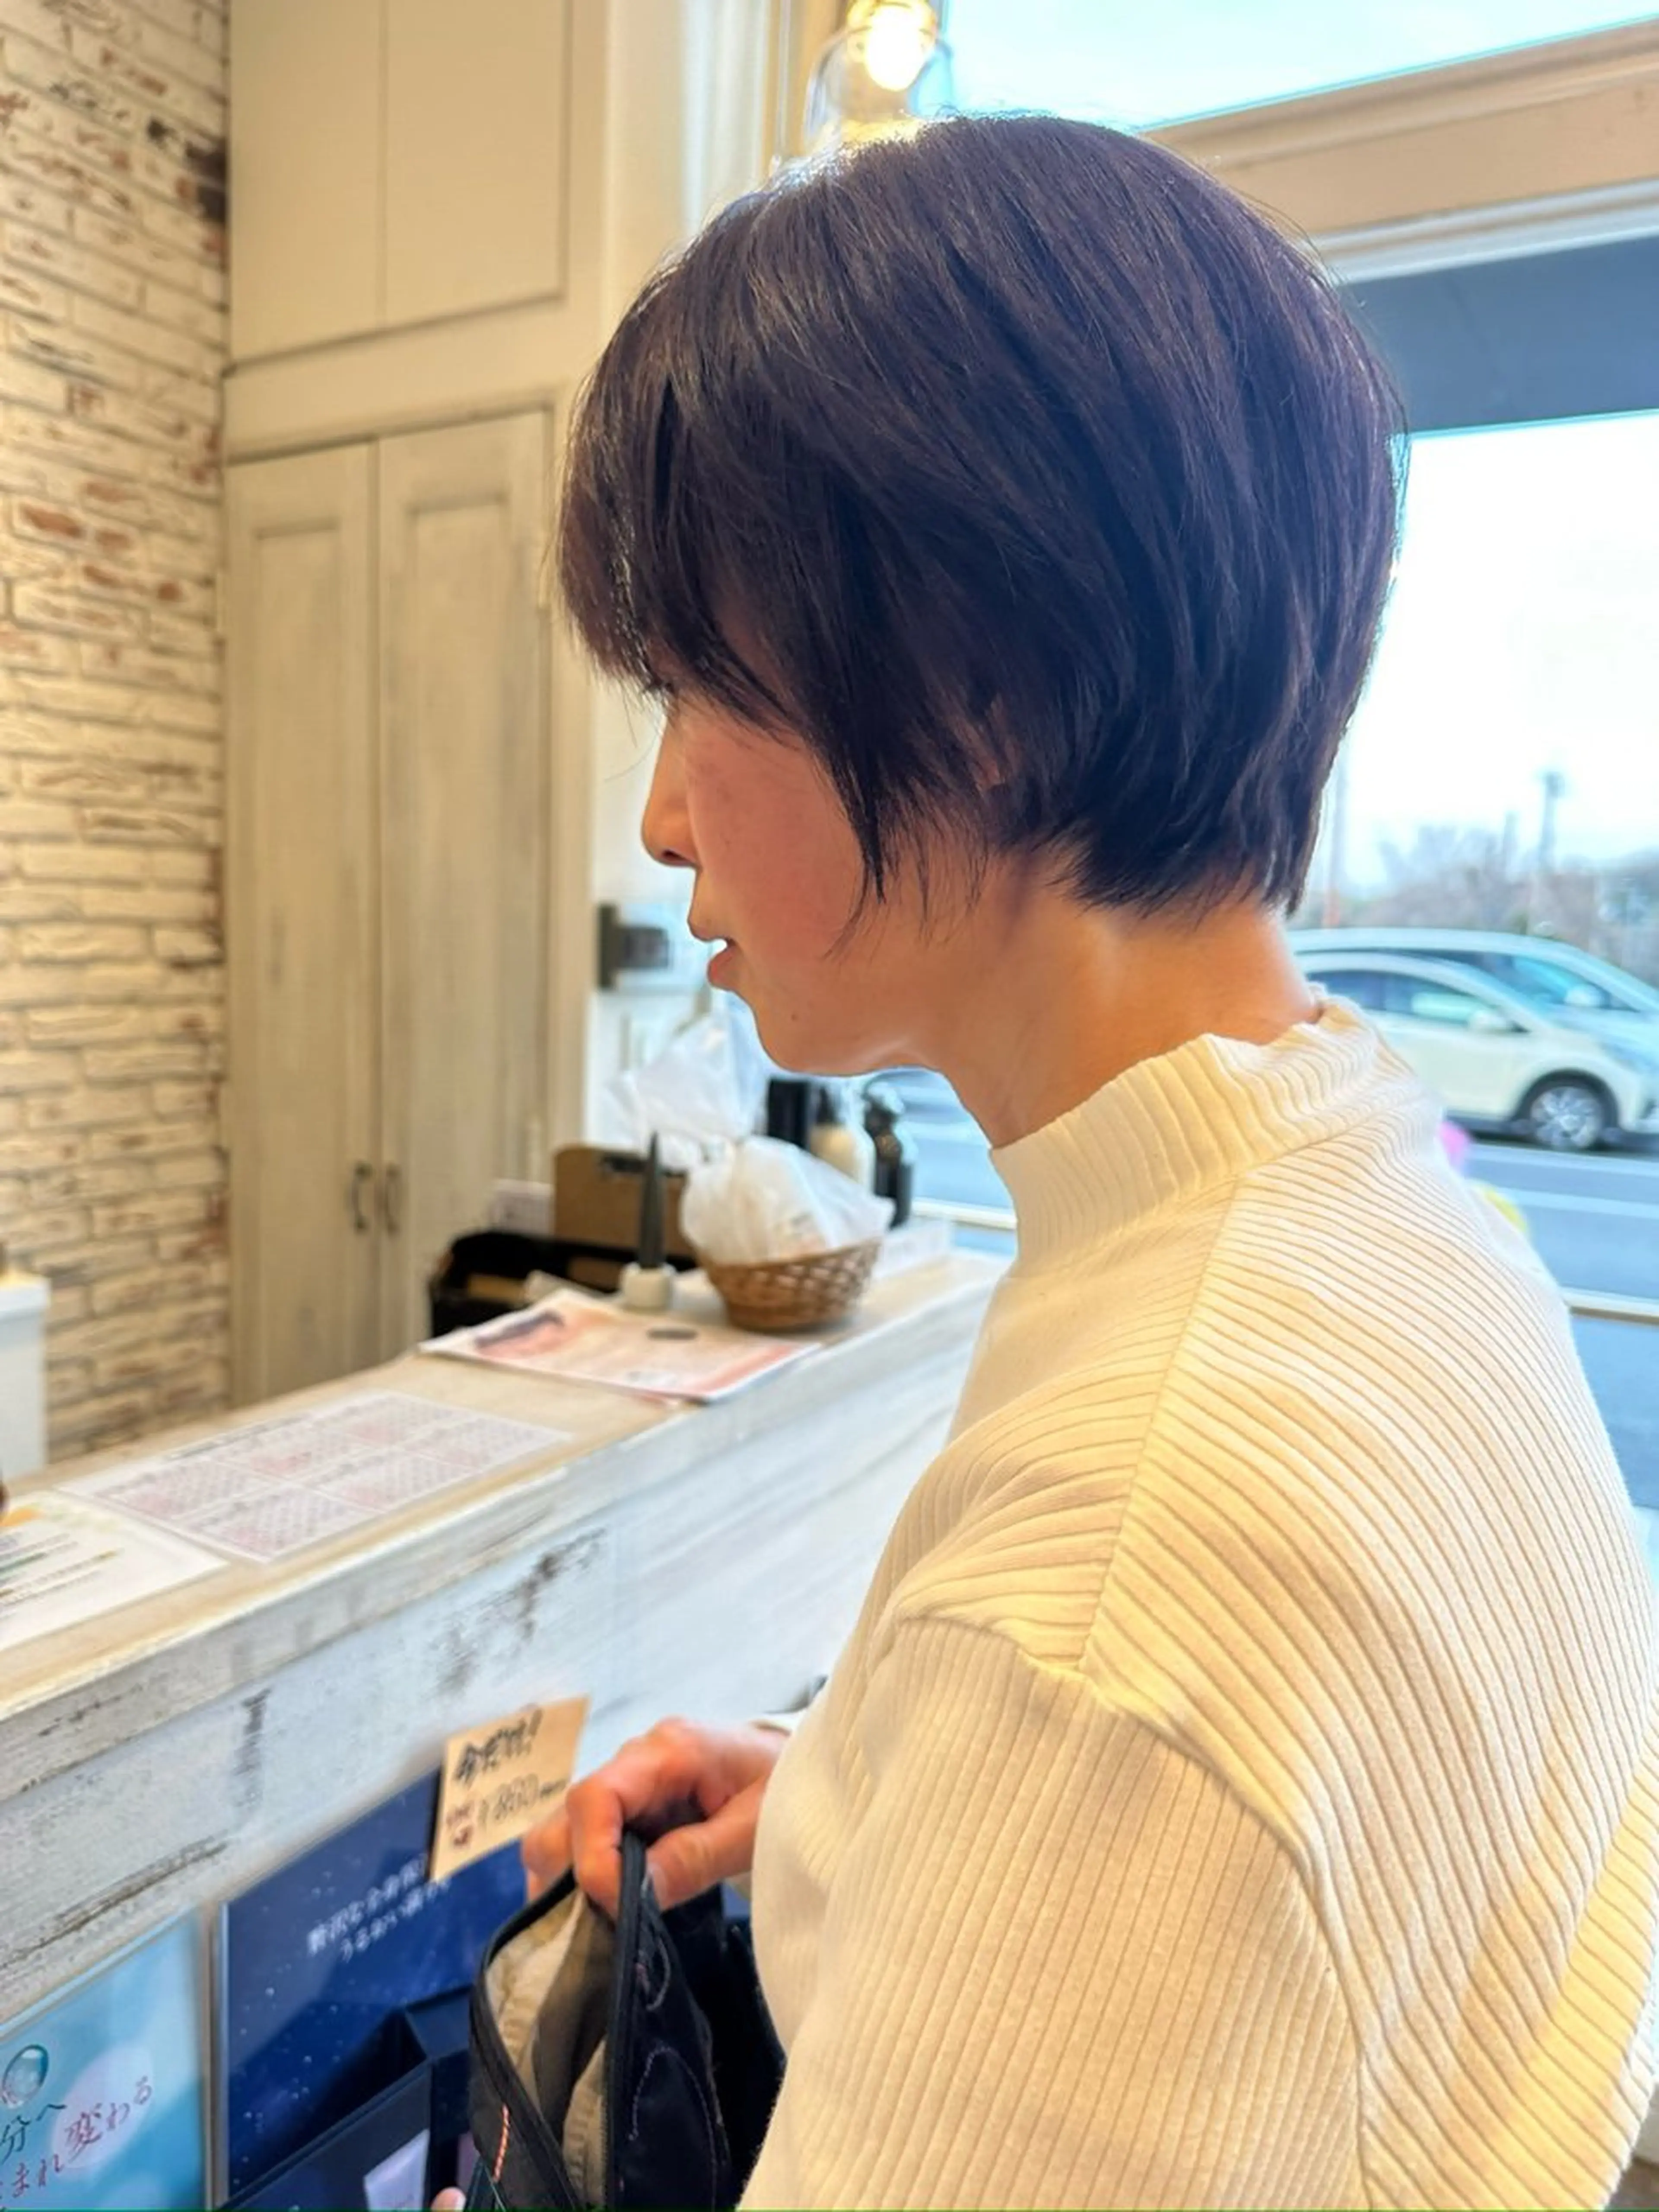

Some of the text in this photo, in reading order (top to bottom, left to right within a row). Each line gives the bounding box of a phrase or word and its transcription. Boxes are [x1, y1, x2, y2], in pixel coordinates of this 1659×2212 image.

[0, 2075, 153, 2198] まれ変わる
